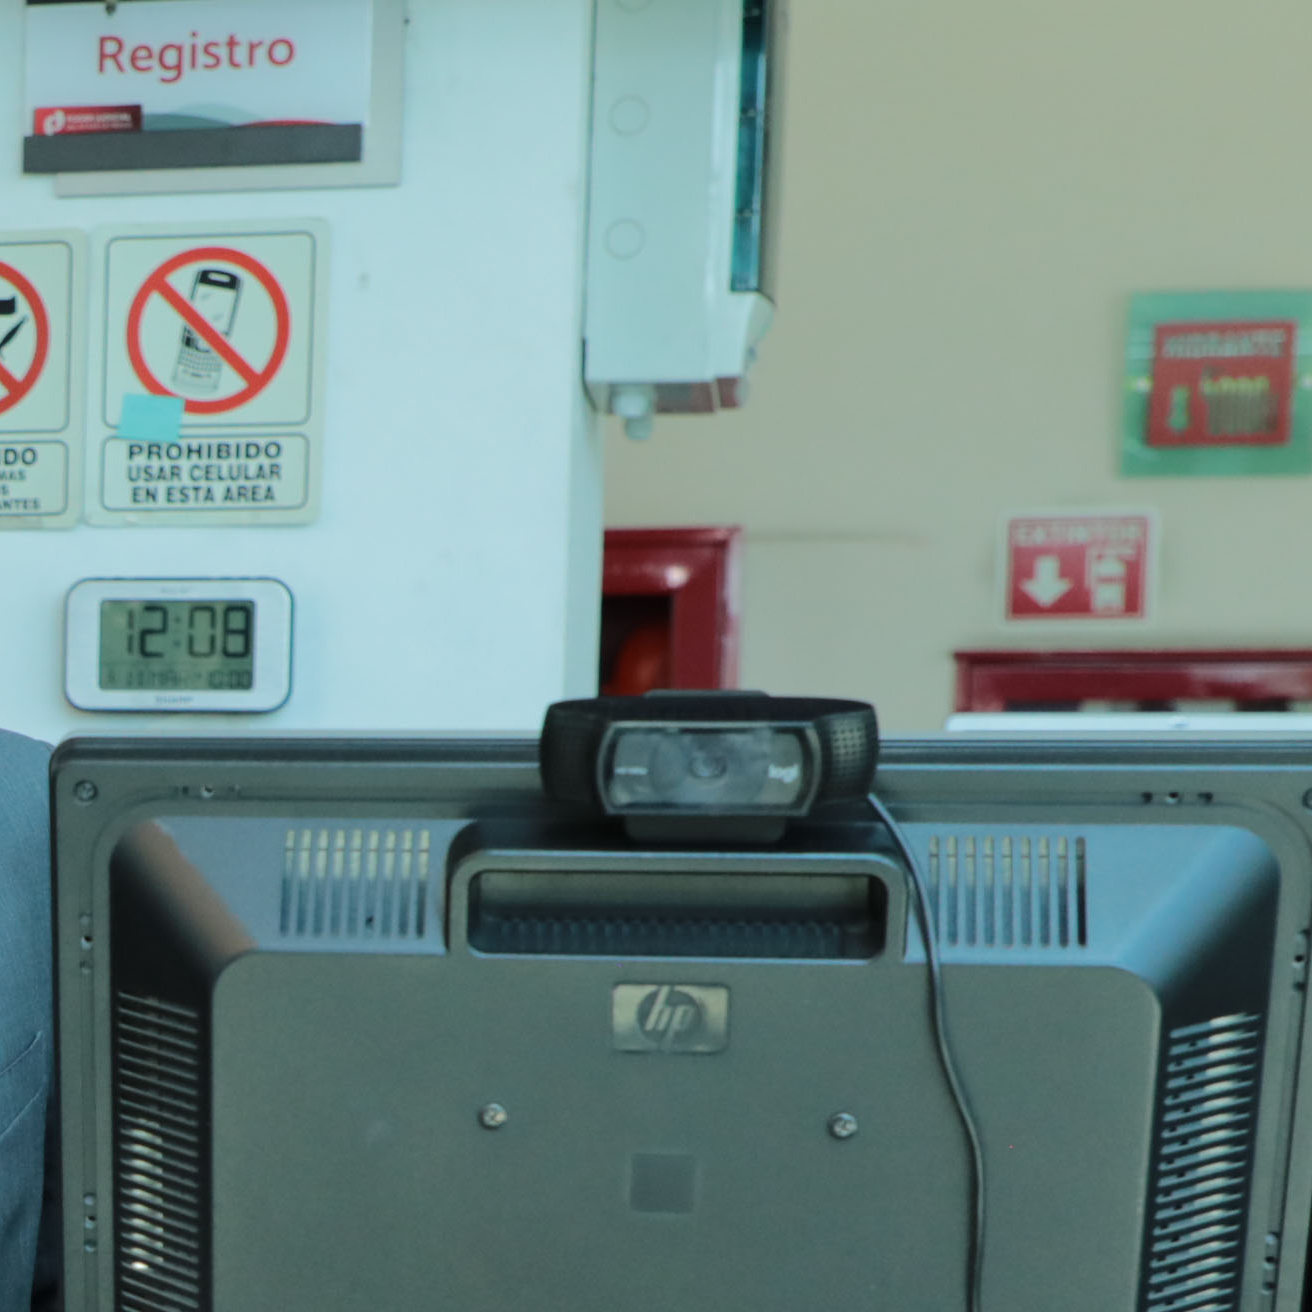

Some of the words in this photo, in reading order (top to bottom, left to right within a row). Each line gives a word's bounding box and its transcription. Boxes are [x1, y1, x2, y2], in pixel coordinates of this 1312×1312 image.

[98, 31, 295, 84] Registro
[129, 442, 282, 461] PROHIBIDO
[128, 464, 183, 482] USAR
[189, 463, 282, 482] CELULAR
[132, 487, 158, 503] EN
[166, 486, 215, 503] ESTA
[223, 485, 277, 503] AREA
